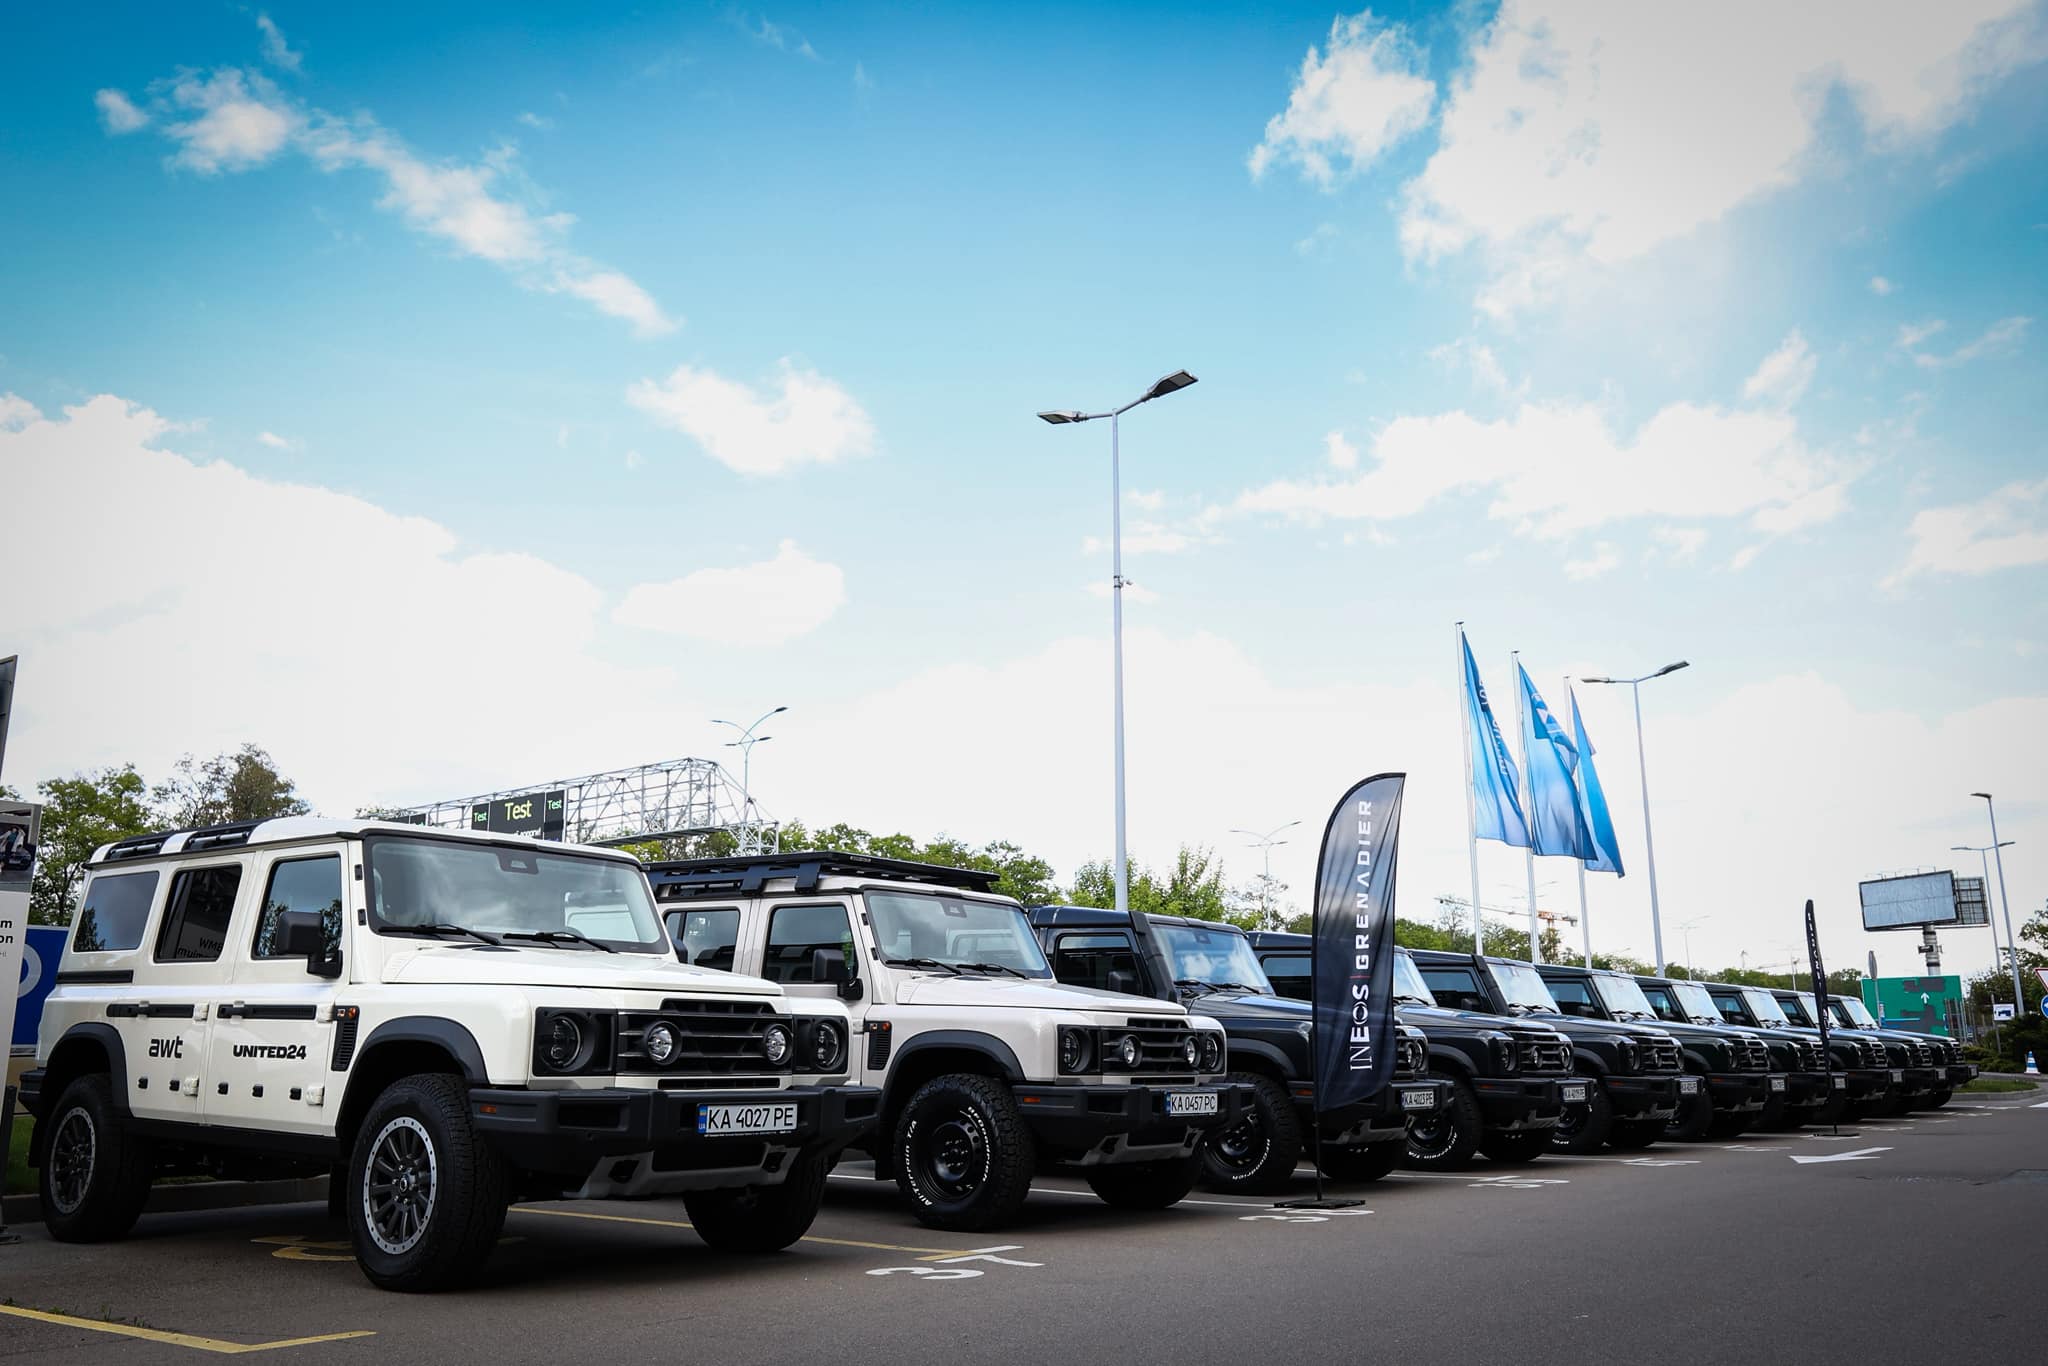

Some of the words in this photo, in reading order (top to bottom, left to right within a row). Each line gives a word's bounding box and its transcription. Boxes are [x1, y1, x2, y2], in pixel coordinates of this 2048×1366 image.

[505, 800, 533, 821] Test
[547, 800, 562, 810] Test
[474, 812, 487, 822] Test
[1355, 801, 1373, 970] GRENADIER
[1350, 984, 1373, 1071] INEOS
[149, 1036, 183, 1058] awt
[233, 1045, 307, 1059] UNITED24
[1171, 1096, 1183, 1111] KA
[1185, 1096, 1204, 1111] 0457
[708, 1109, 731, 1129] KA
[736, 1108, 770, 1128] 4027
[774, 1107, 794, 1127] PE
